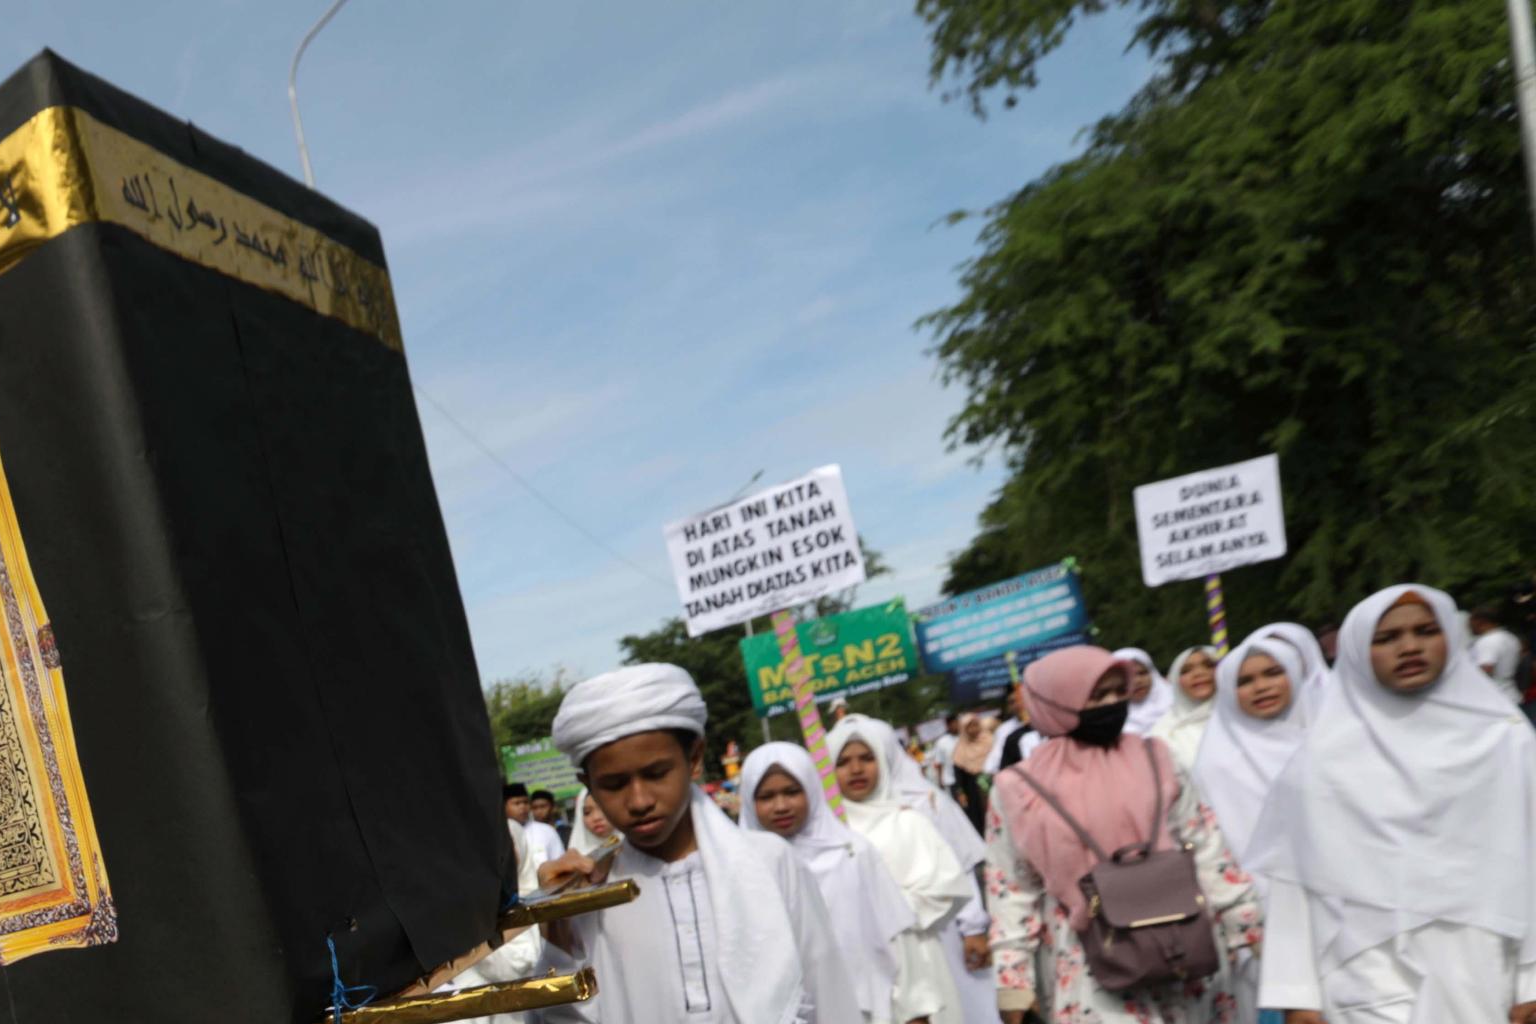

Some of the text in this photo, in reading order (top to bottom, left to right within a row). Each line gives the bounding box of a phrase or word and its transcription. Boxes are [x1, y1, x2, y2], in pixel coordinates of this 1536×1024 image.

[683, 480, 822, 543] HARI INI KITA
[1151, 490, 1263, 530] SEMENTARA
[1179, 474, 1240, 502] DUNIA
[685, 500, 836, 568] DI ATAS TANAH
[1154, 531, 1268, 568] SELAMANYA
[1168, 513, 1247, 545] AKHIRAT
[689, 525, 846, 593] MUNGKIN ESOK
[684, 587, 744, 619] TANAH
[811, 549, 858, 577] KITA
[763, 674, 841, 705] BADA
[845, 656, 906, 684] ACEH
